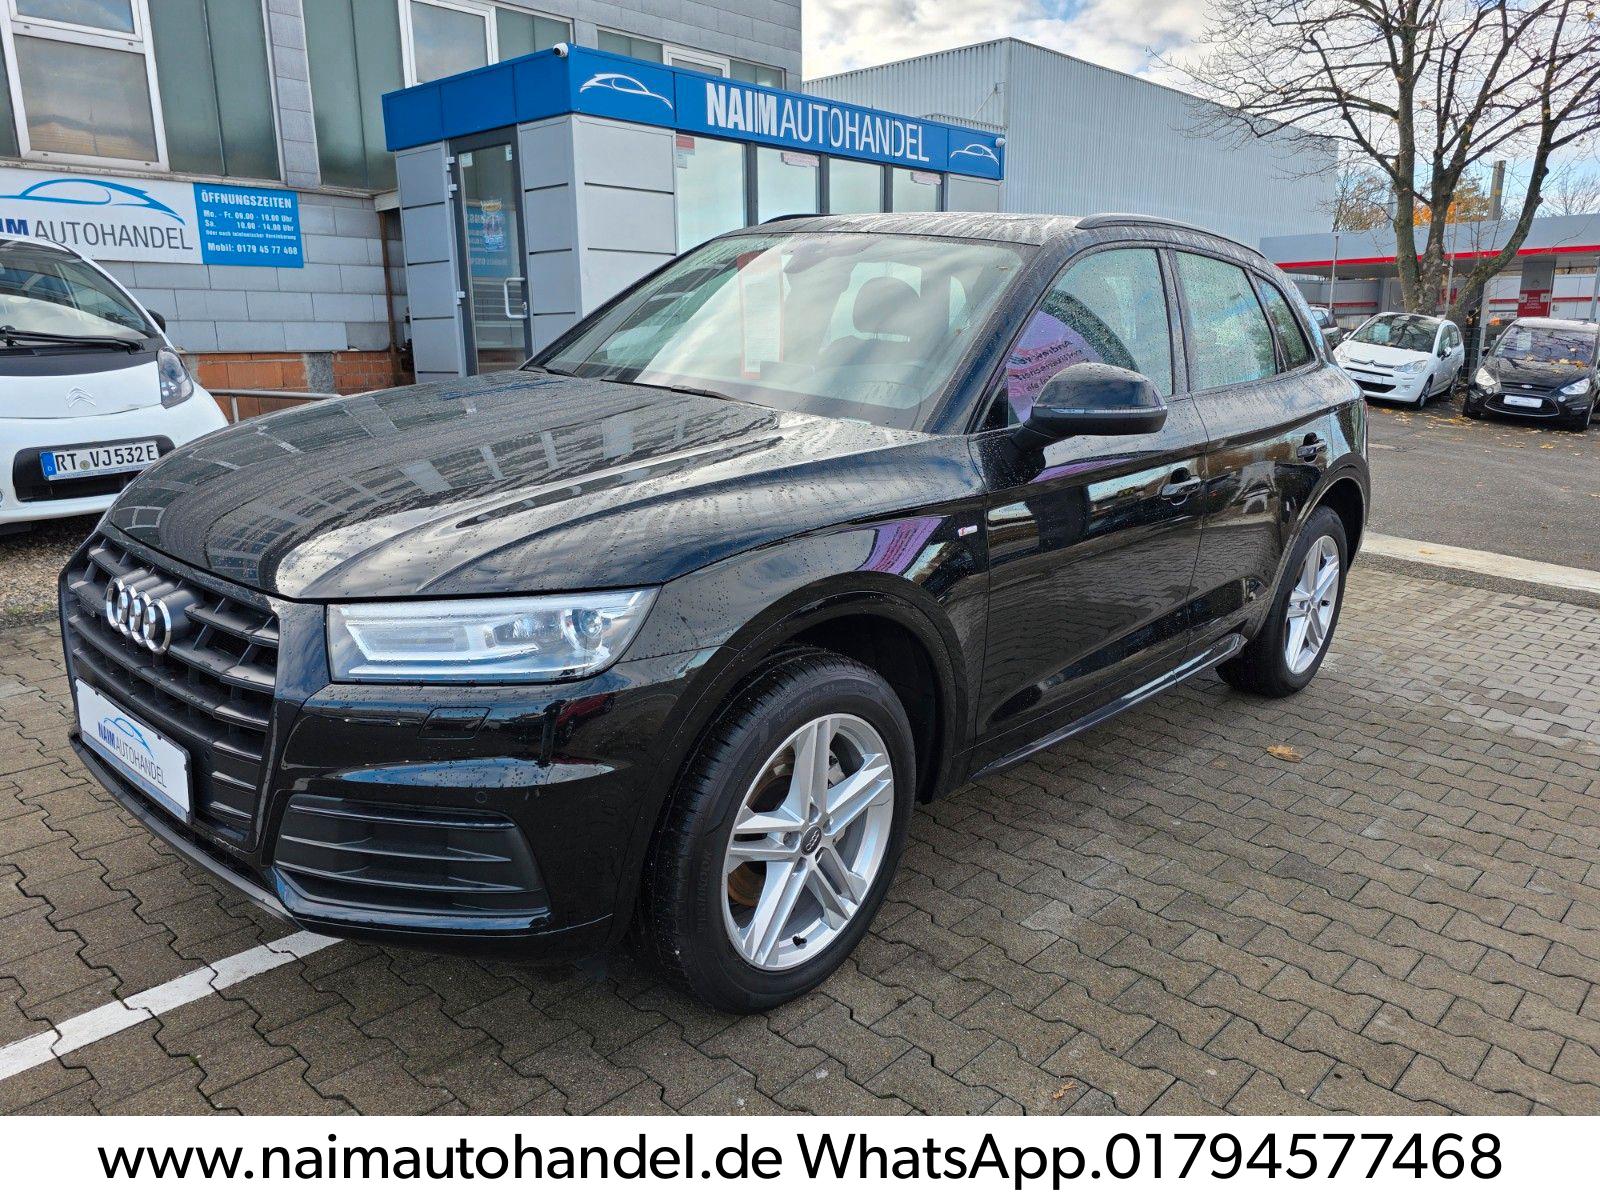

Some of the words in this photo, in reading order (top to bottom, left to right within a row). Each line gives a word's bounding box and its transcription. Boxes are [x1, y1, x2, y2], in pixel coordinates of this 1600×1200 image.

[706, 82, 777, 137] NAIM
[779, 97, 930, 163] AUTOHANDEL
[201, 189, 292, 209] ÖFFNUNGSZEITEN
[203, 209, 217, 218] Mo.
[281, 214, 293, 222] Uhr
[35, 220, 193, 250] AUTOHANDEL
[204, 219, 216, 227] Sa.
[282, 224, 294, 232] Uhr
[207, 242, 234, 252] Mobil:
[236, 243, 257, 253] 0179
[259, 244, 269, 254] 45
[271, 245, 281, 255] 77
[55, 453, 77, 472] RT
[98, 721, 116, 750] NAIM
[115, 735, 167, 788] AUTOHANDEL
